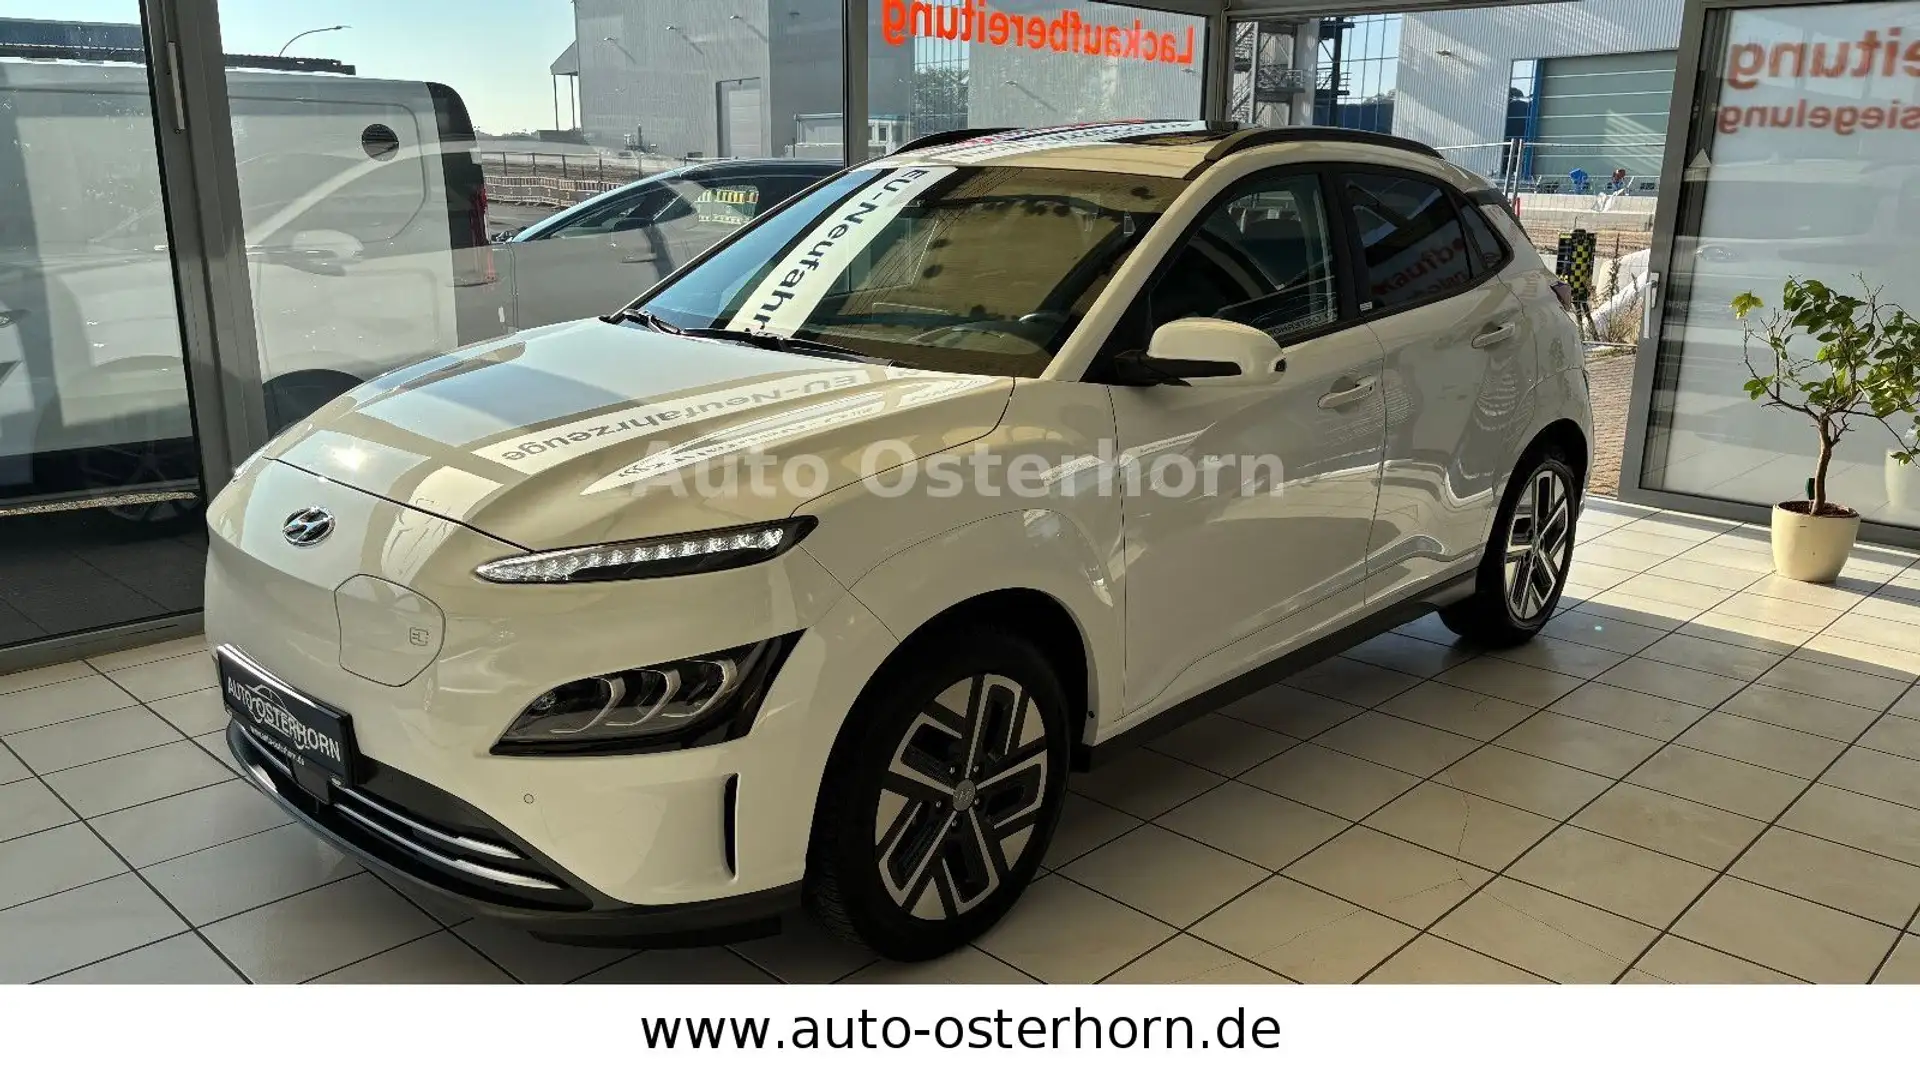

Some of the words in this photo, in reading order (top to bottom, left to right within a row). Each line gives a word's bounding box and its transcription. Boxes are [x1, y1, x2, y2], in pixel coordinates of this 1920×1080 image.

[744, 168, 930, 332] EU-Neufahr
[501, 374, 857, 462] EU-Neufahrzeuge
[227, 676, 253, 711] AUTO
[255, 697, 341, 762] OSTERHORN
